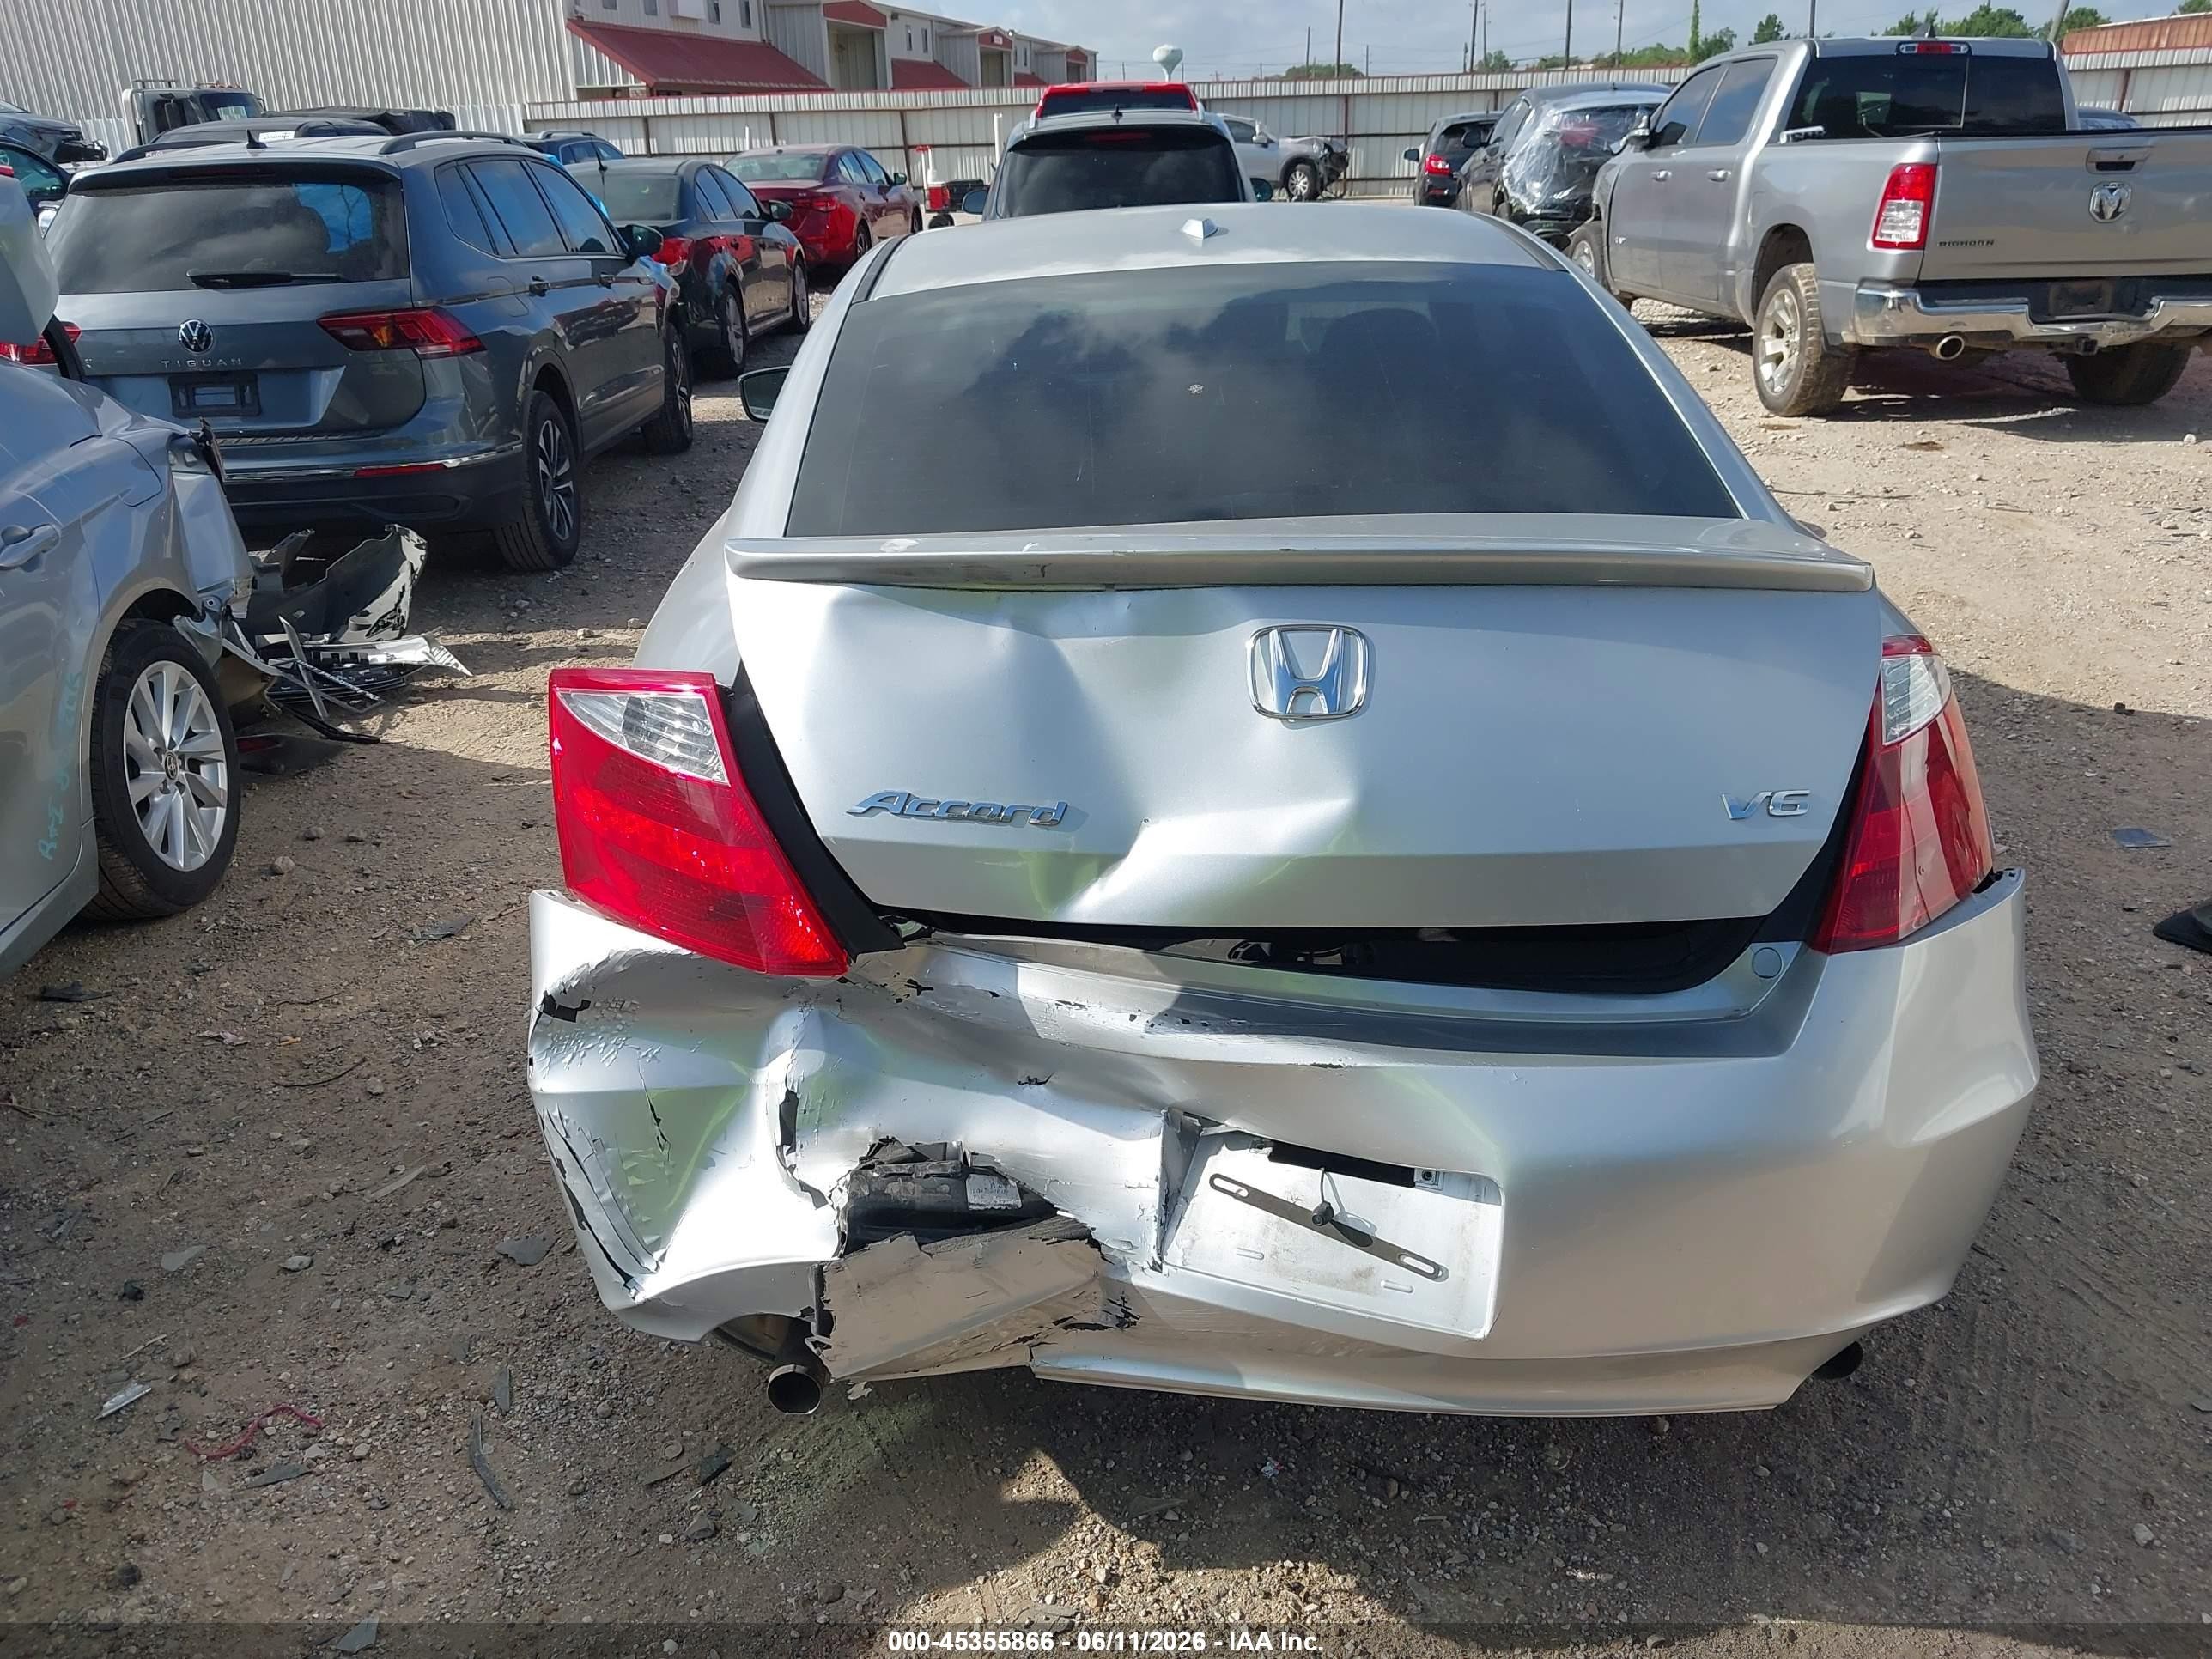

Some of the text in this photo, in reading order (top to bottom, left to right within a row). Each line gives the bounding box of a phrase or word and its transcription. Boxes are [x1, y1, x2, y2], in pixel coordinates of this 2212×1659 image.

[160, 357, 242, 368] TIGUAN
[845, 789, 1068, 826] Accord
[1721, 789, 1811, 820] V6
